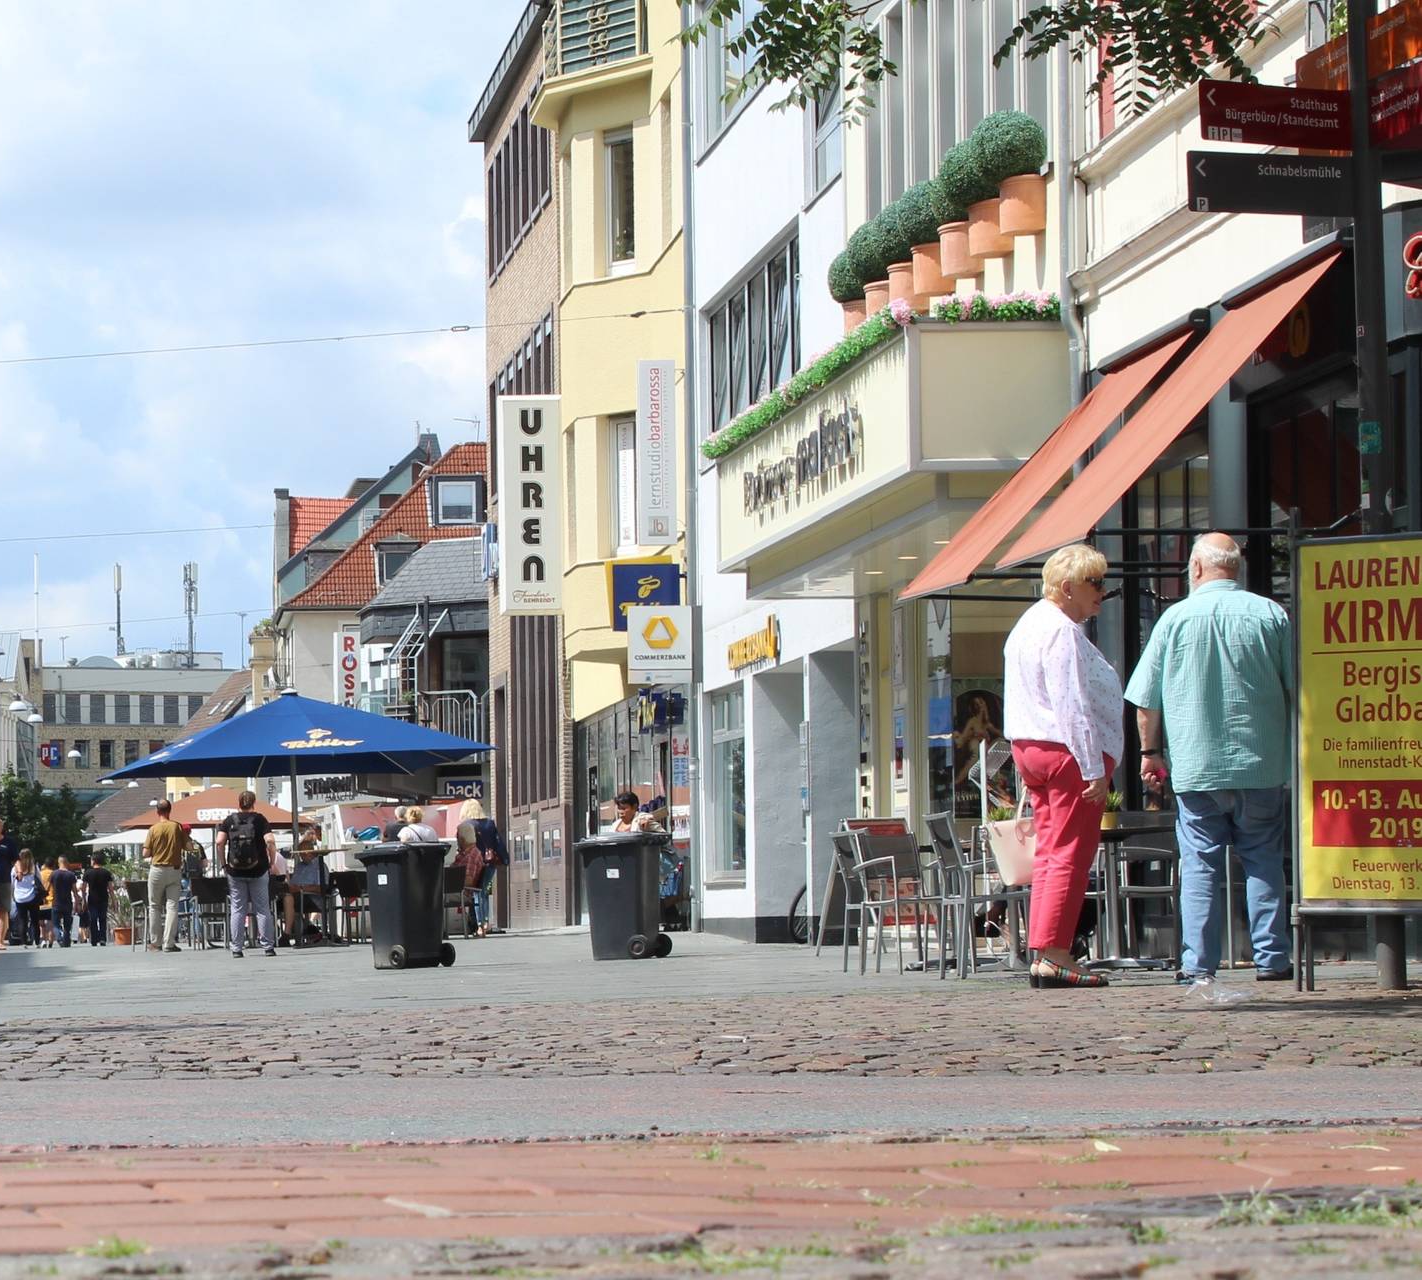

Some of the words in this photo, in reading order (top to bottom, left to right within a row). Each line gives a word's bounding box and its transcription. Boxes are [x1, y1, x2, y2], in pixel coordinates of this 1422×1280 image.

[1290, 97, 1339, 112] Stadthaus
[1258, 164, 1342, 178] Schnabelsmühle
[647, 367, 662, 510] lernstudiobarbarossa
[520, 408, 544, 583] UHREN
[1314, 556, 1420, 590] LAUREN
[1324, 598, 1422, 643] KIRM
[1342, 657, 1421, 693] Bergis
[280, 738, 365, 750] Tchibo
[1323, 738, 1343, 751] Die
[1321, 788, 1390, 810] 10.-13.
[1369, 817, 1422, 840] 2019
[1352, 858, 1422, 873] Feuerwerk
[1332, 876, 1396, 894] Dienstag,
[1399, 877, 1421, 891] 13.
